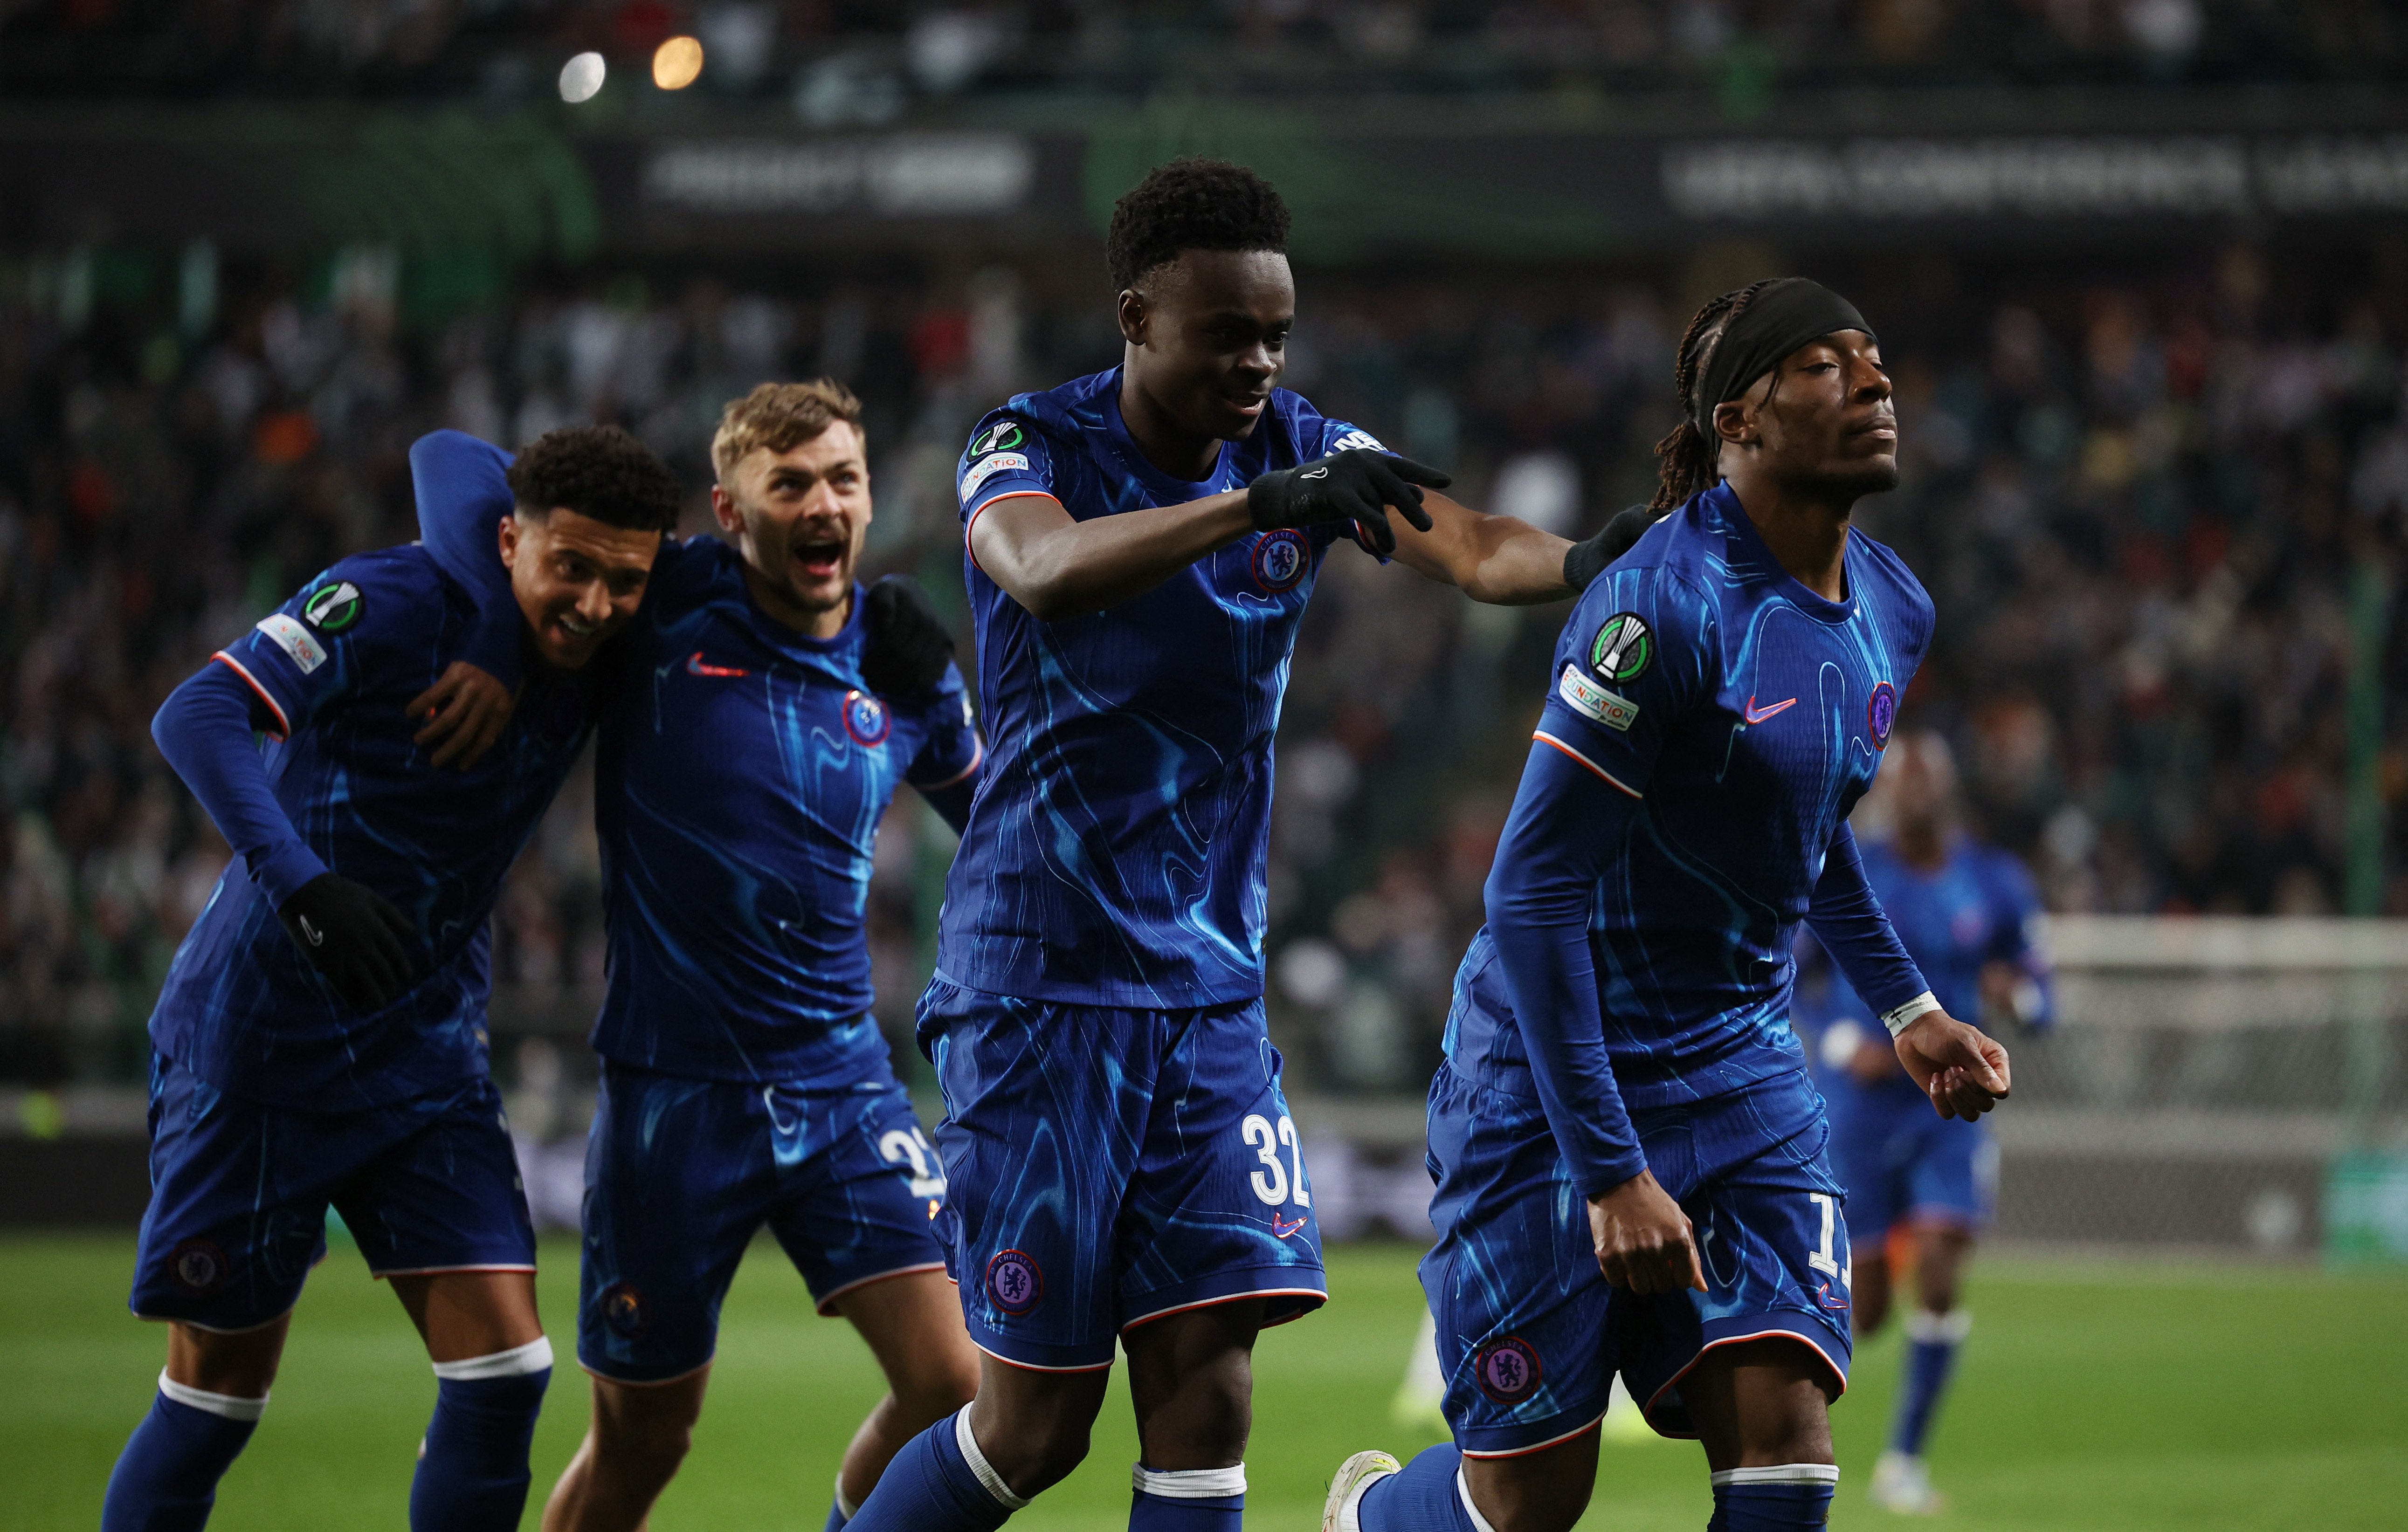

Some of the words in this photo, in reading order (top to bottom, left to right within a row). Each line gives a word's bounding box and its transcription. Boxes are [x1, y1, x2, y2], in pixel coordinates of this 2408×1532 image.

[1261, 532, 1295, 550] CHELSEA
[1564, 674, 1632, 722] FOUNDATION
[1242, 1114, 1310, 1208] 32
[998, 1254, 1032, 1271] CHELSEA
[1485, 1340, 1523, 1356] CHELSEA
